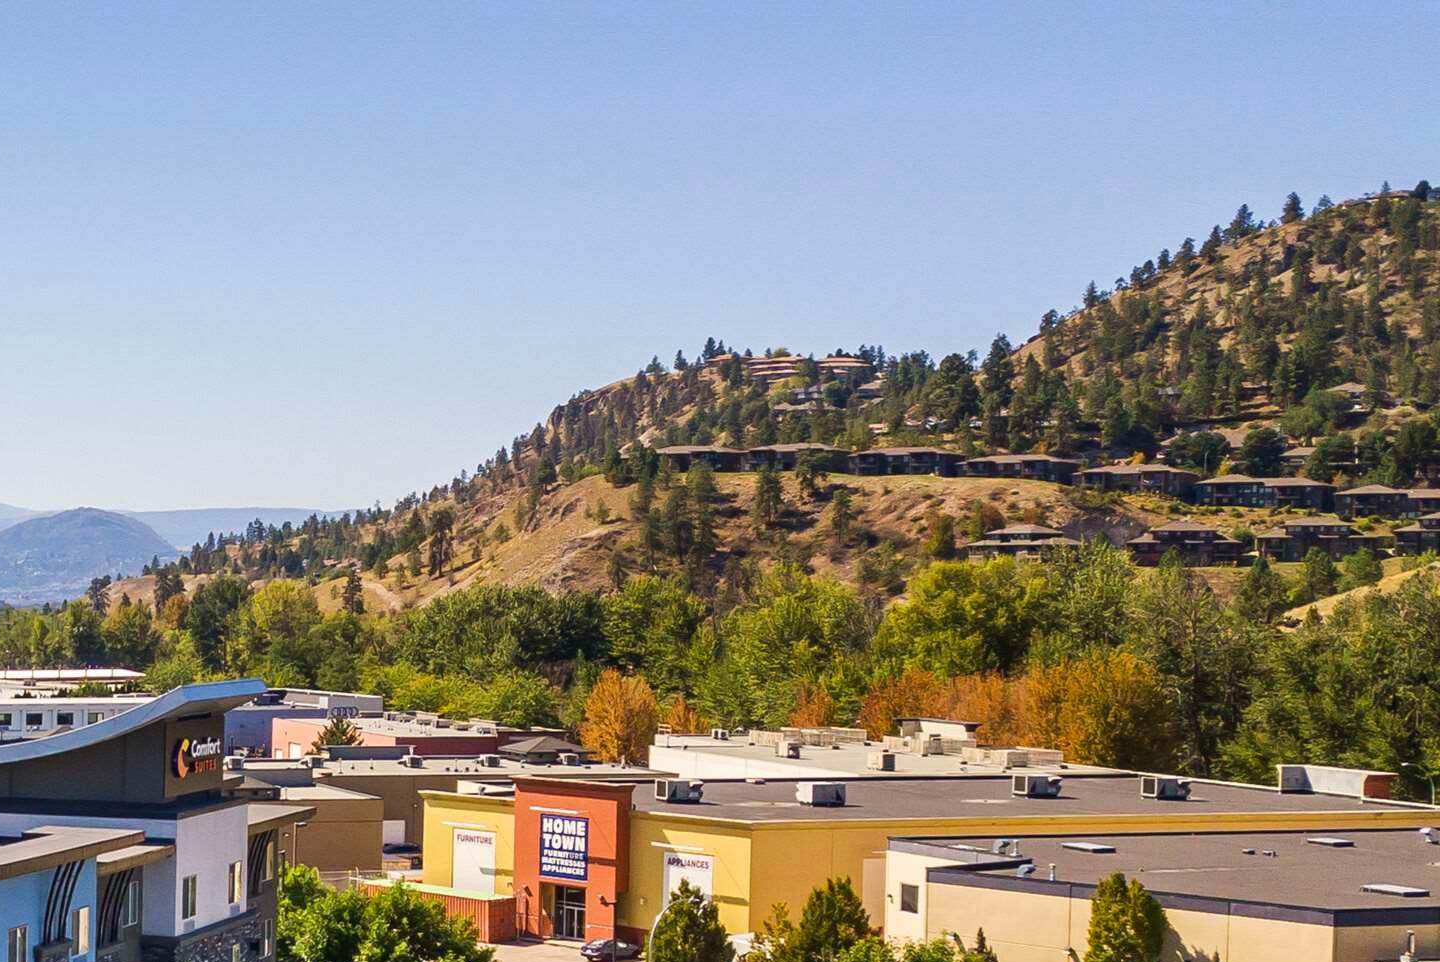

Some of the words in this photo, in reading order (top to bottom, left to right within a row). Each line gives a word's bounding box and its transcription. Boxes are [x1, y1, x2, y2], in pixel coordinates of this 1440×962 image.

[191, 736, 221, 758] Comfort
[542, 818, 586, 836] HOME
[456, 833, 493, 845] FURNITURE
[542, 833, 586, 852] TOWN
[543, 848, 585, 860] FURNITURE
[542, 856, 586, 868] MATTRESSES
[666, 857, 710, 870] APPLIANCES
[542, 864, 585, 876] APPLIANCES
